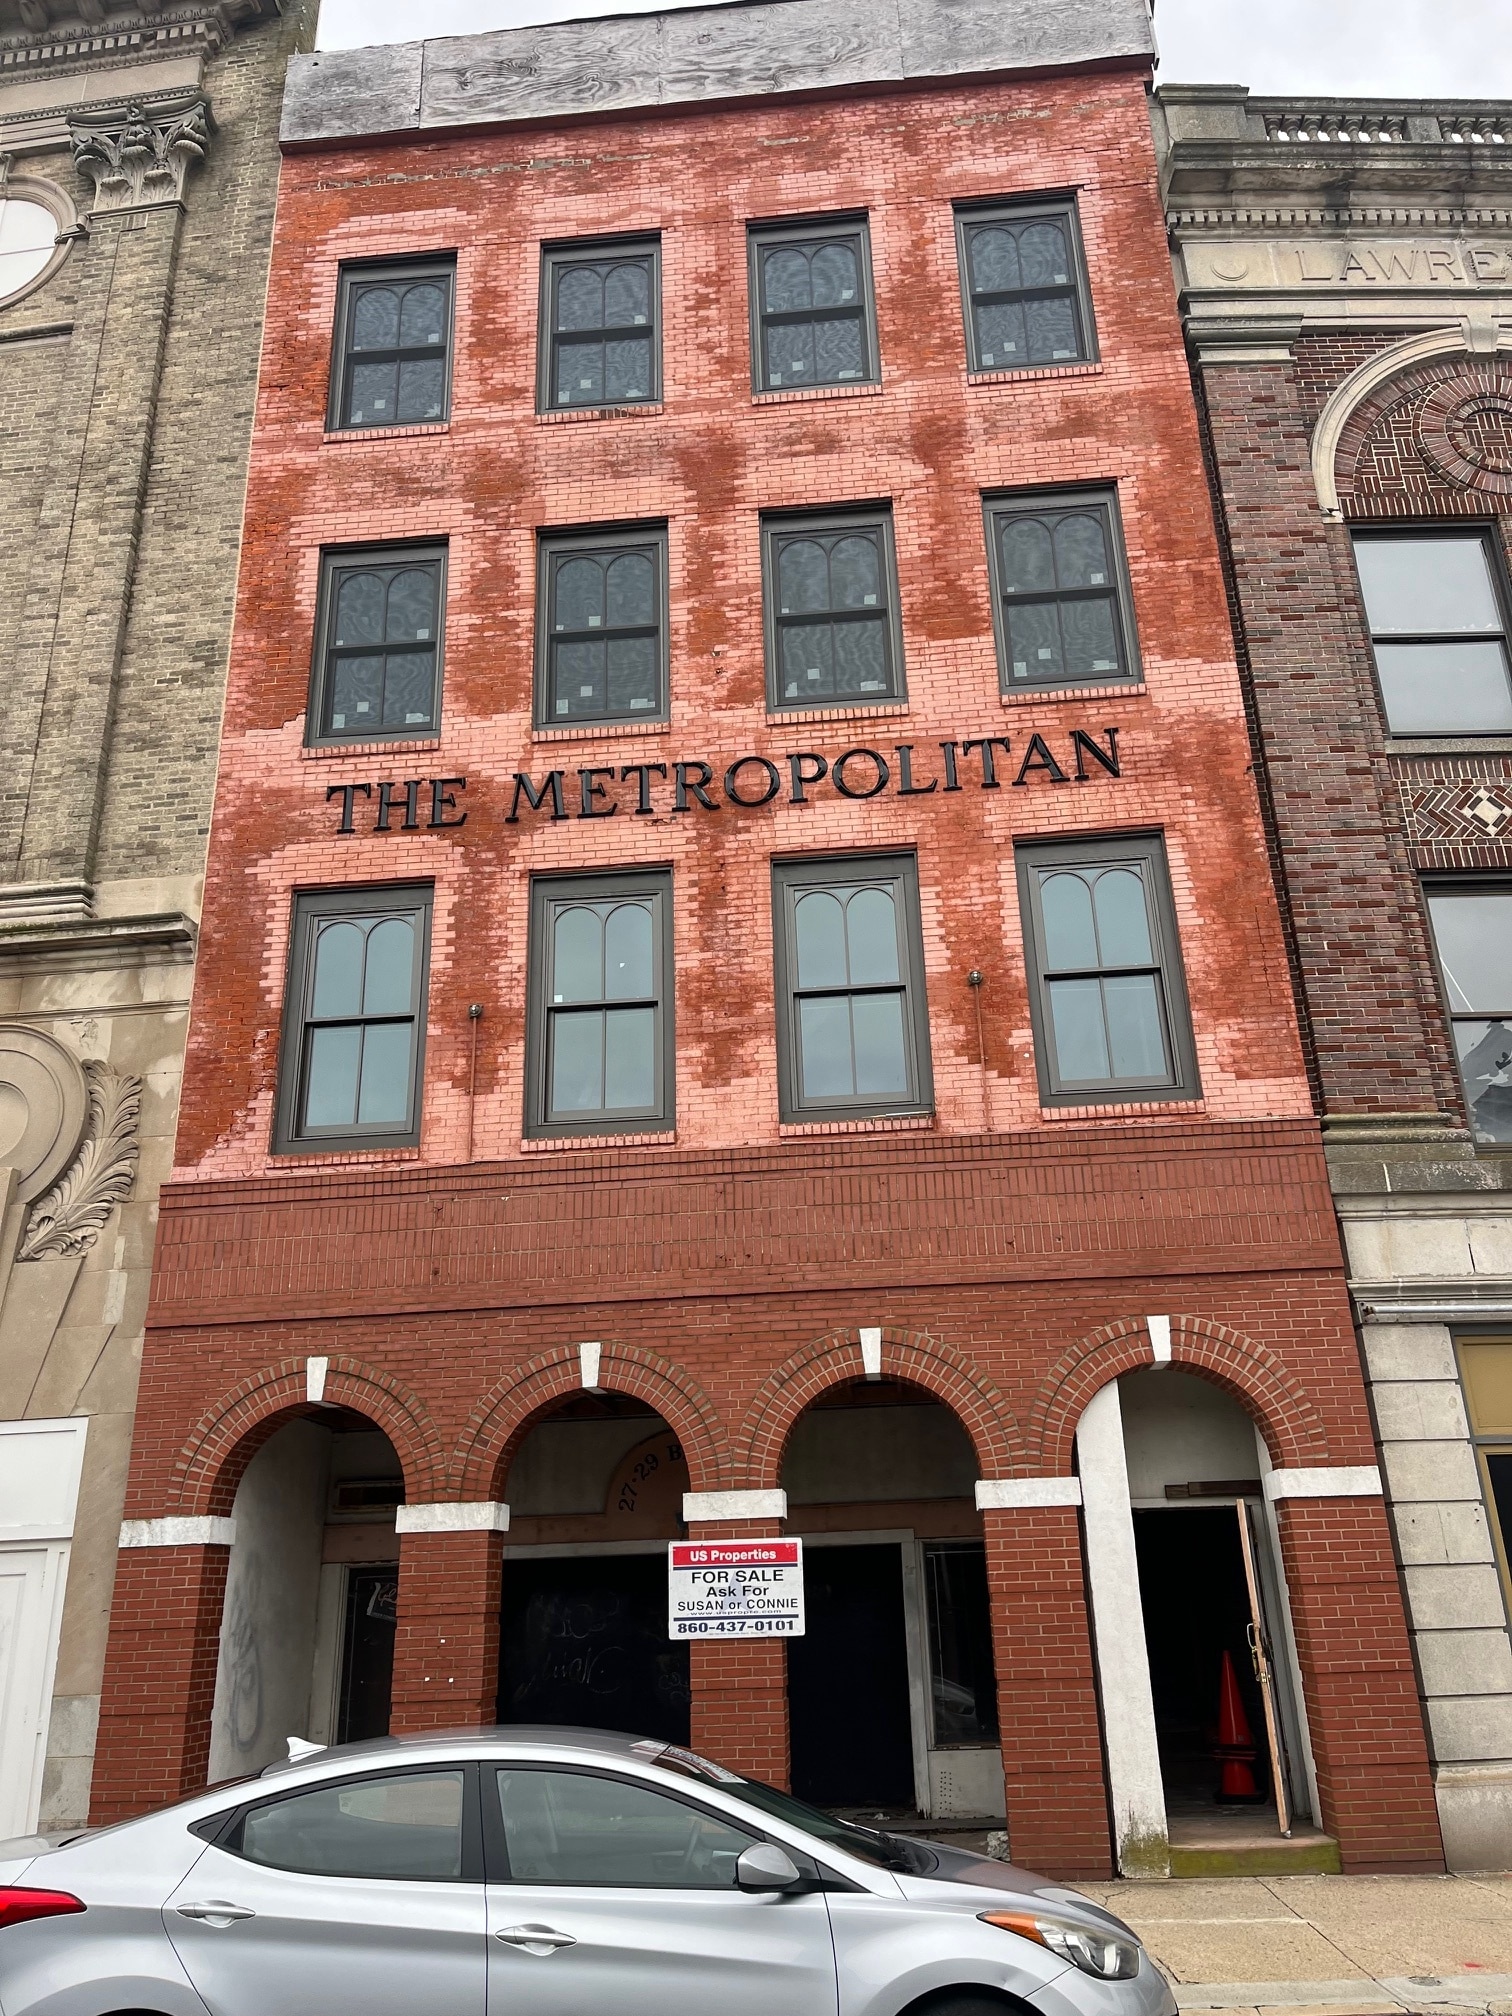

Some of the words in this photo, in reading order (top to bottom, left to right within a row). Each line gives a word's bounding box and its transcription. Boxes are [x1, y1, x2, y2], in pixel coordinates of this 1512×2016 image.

[325, 776, 468, 834] THE
[505, 727, 1122, 824] METROPOLITAN
[690, 1551, 707, 1562] US
[711, 1549, 777, 1562] Properties
[692, 1571, 729, 1584] FOR
[735, 1569, 784, 1582] SALE
[706, 1585, 737, 1598] Ask
[742, 1585, 769, 1597] For
[677, 1600, 724, 1612] SUSAN
[728, 1601, 742, 1610] or
[746, 1598, 799, 1610] CONNIE
[677, 1620, 794, 1633] 860-437-0101
